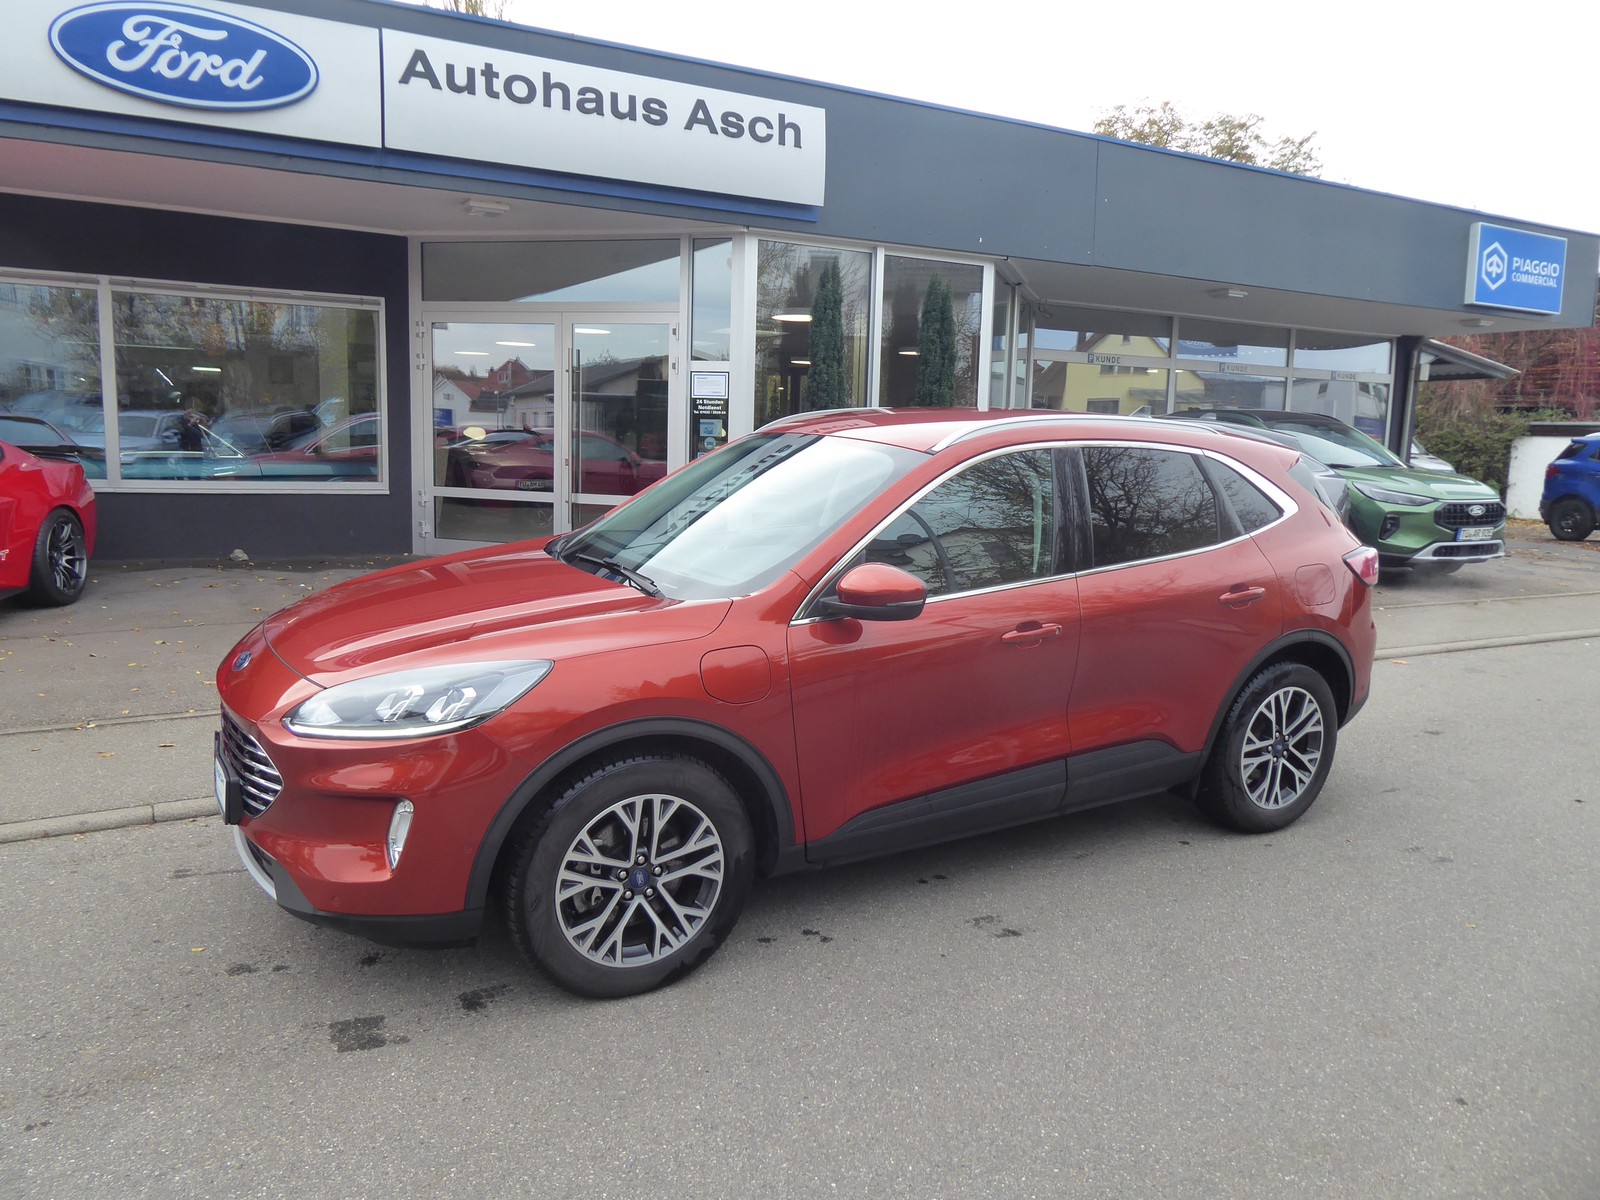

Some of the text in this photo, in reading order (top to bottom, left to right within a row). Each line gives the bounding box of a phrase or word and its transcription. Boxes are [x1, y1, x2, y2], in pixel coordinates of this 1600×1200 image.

[106, 15, 267, 90] Ford
[398, 48, 802, 149] Autohaus Asch
[1512, 256, 1560, 277] PIAGGIO
[1511, 272, 1558, 287] COMMERCIAL
[1095, 355, 1120, 364] KUNDE
[1226, 363, 1248, 372] KUNDE
